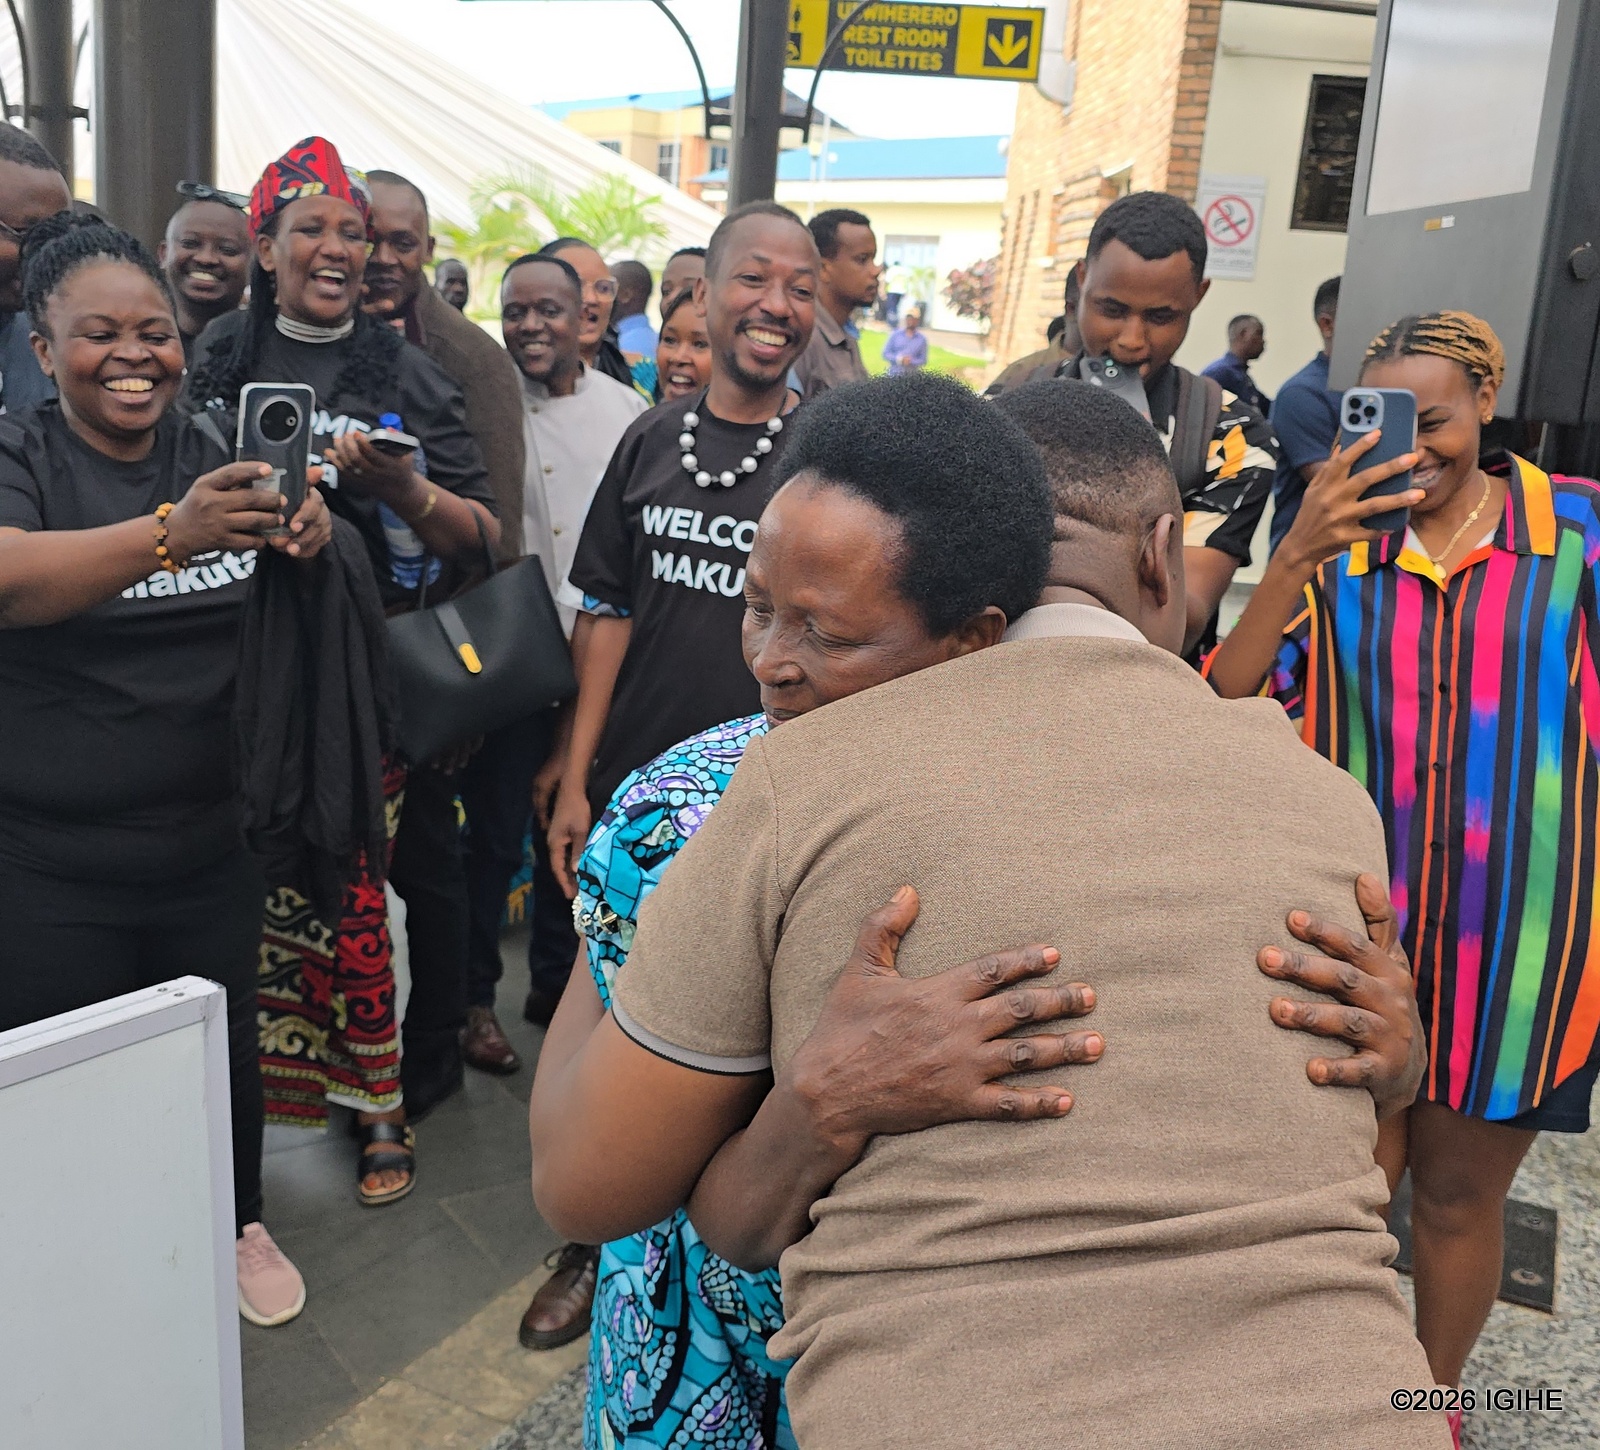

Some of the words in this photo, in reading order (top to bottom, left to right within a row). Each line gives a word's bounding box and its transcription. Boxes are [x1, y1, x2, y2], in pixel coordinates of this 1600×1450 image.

[843, 24, 891, 45] REST
[893, 27, 948, 48] ROOM
[844, 47, 943, 71] TOILETTES
